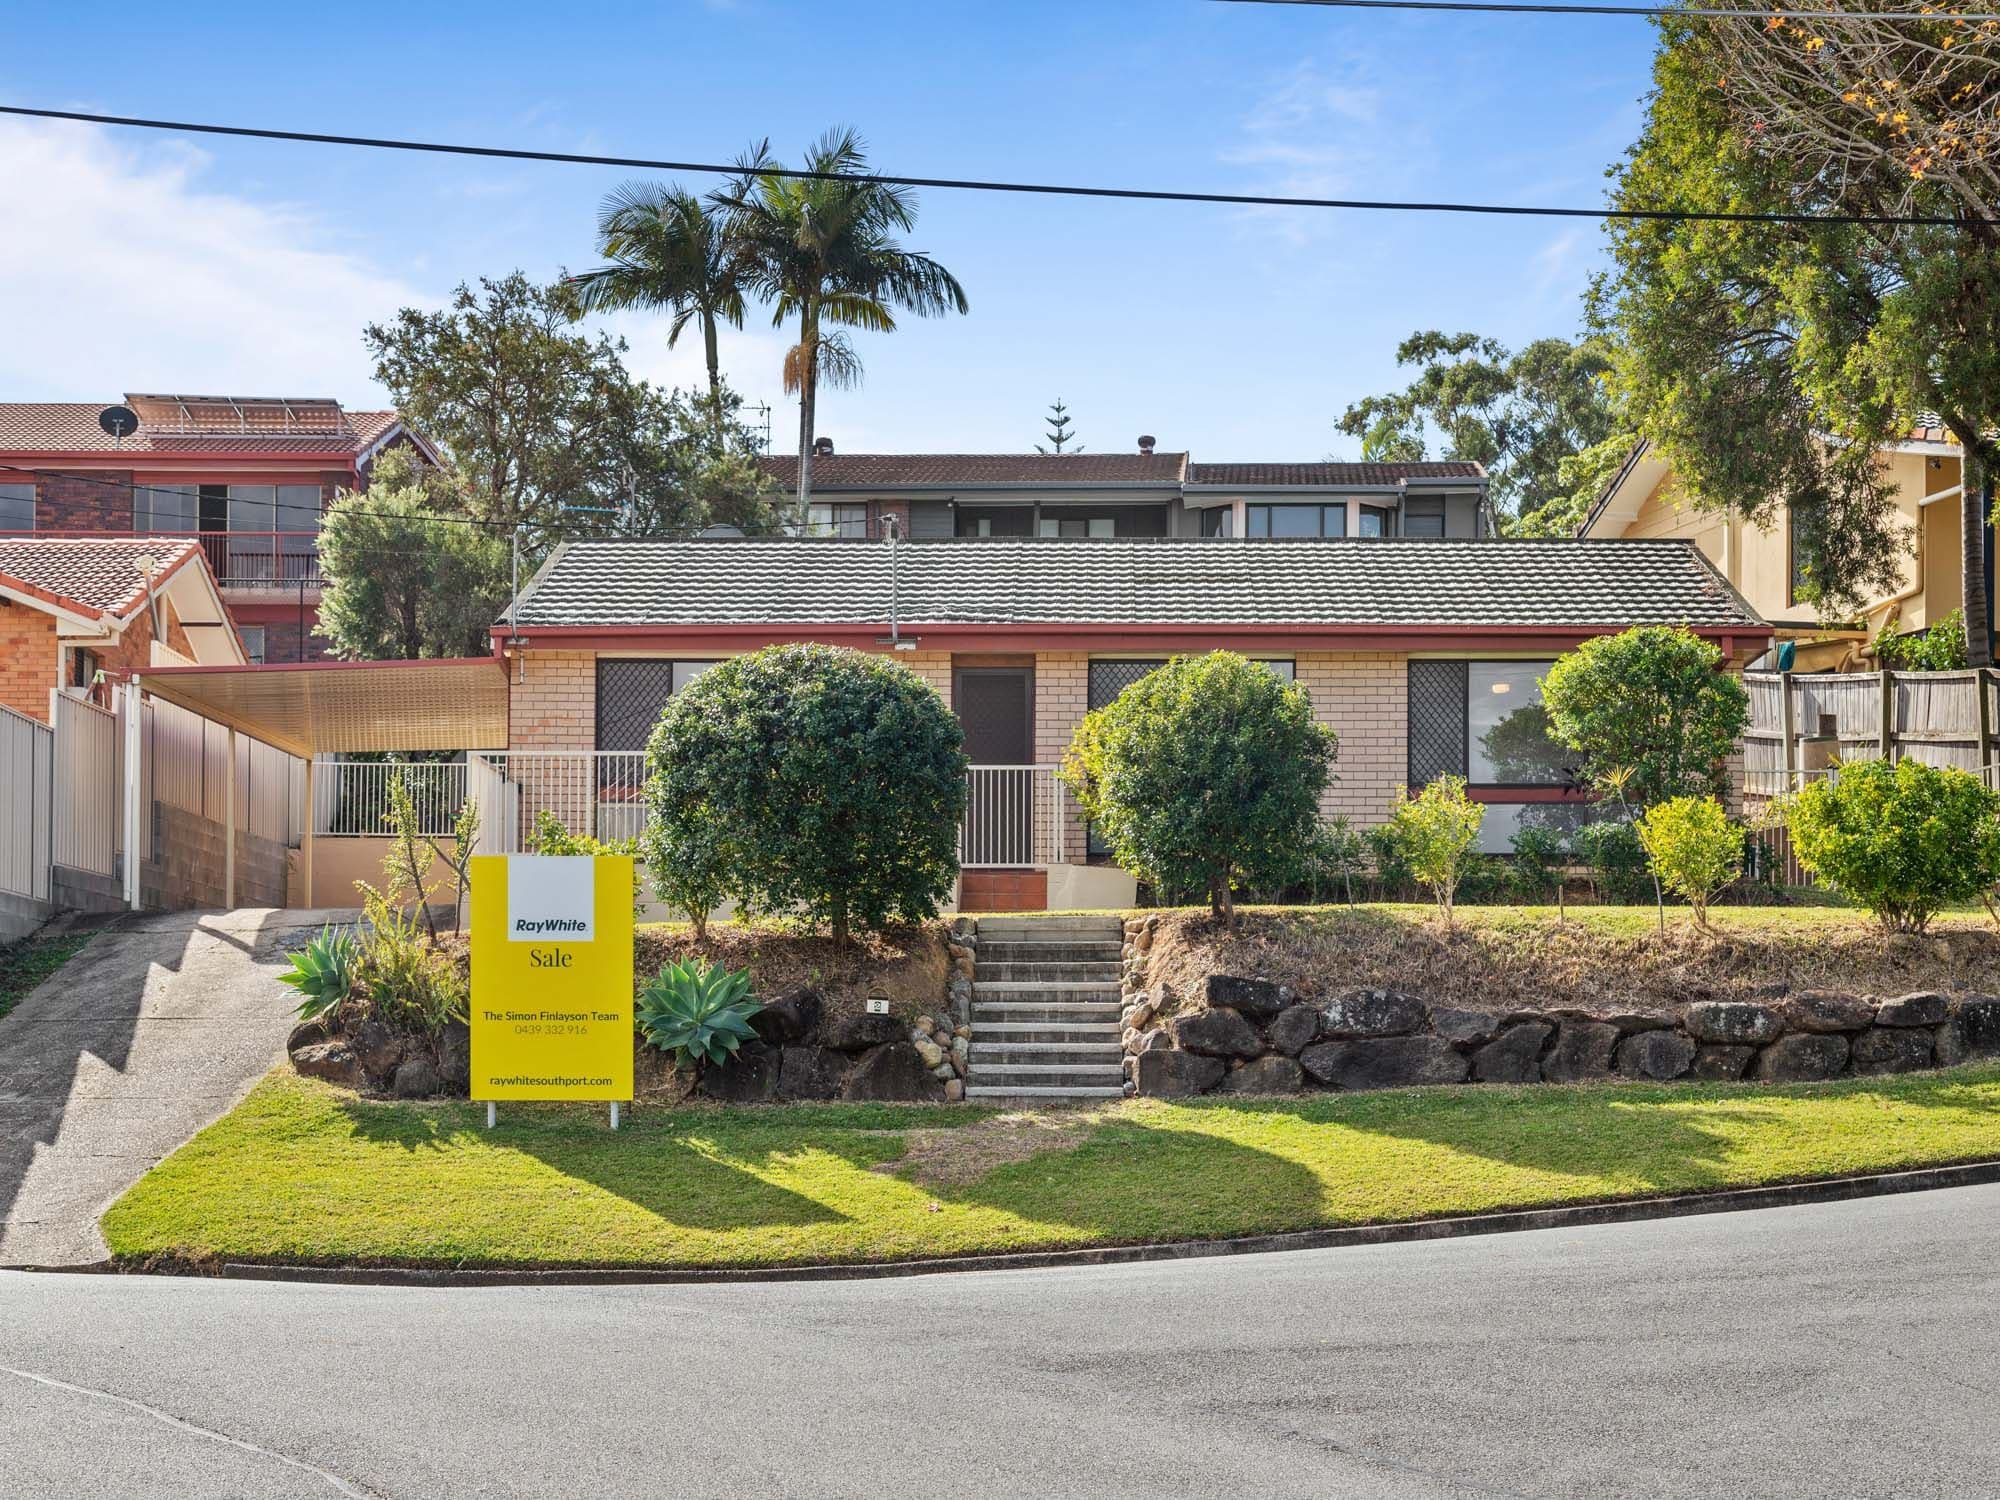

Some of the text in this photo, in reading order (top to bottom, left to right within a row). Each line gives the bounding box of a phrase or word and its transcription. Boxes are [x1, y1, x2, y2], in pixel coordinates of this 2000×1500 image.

[515, 919, 587, 933] RayWhite
[530, 948, 573, 968] Sale
[484, 1011, 619, 1023] The Simon Finlayson Team
[514, 1025, 588, 1035] 0439 332 916
[489, 1075, 613, 1088] raywhitesouthport.com
